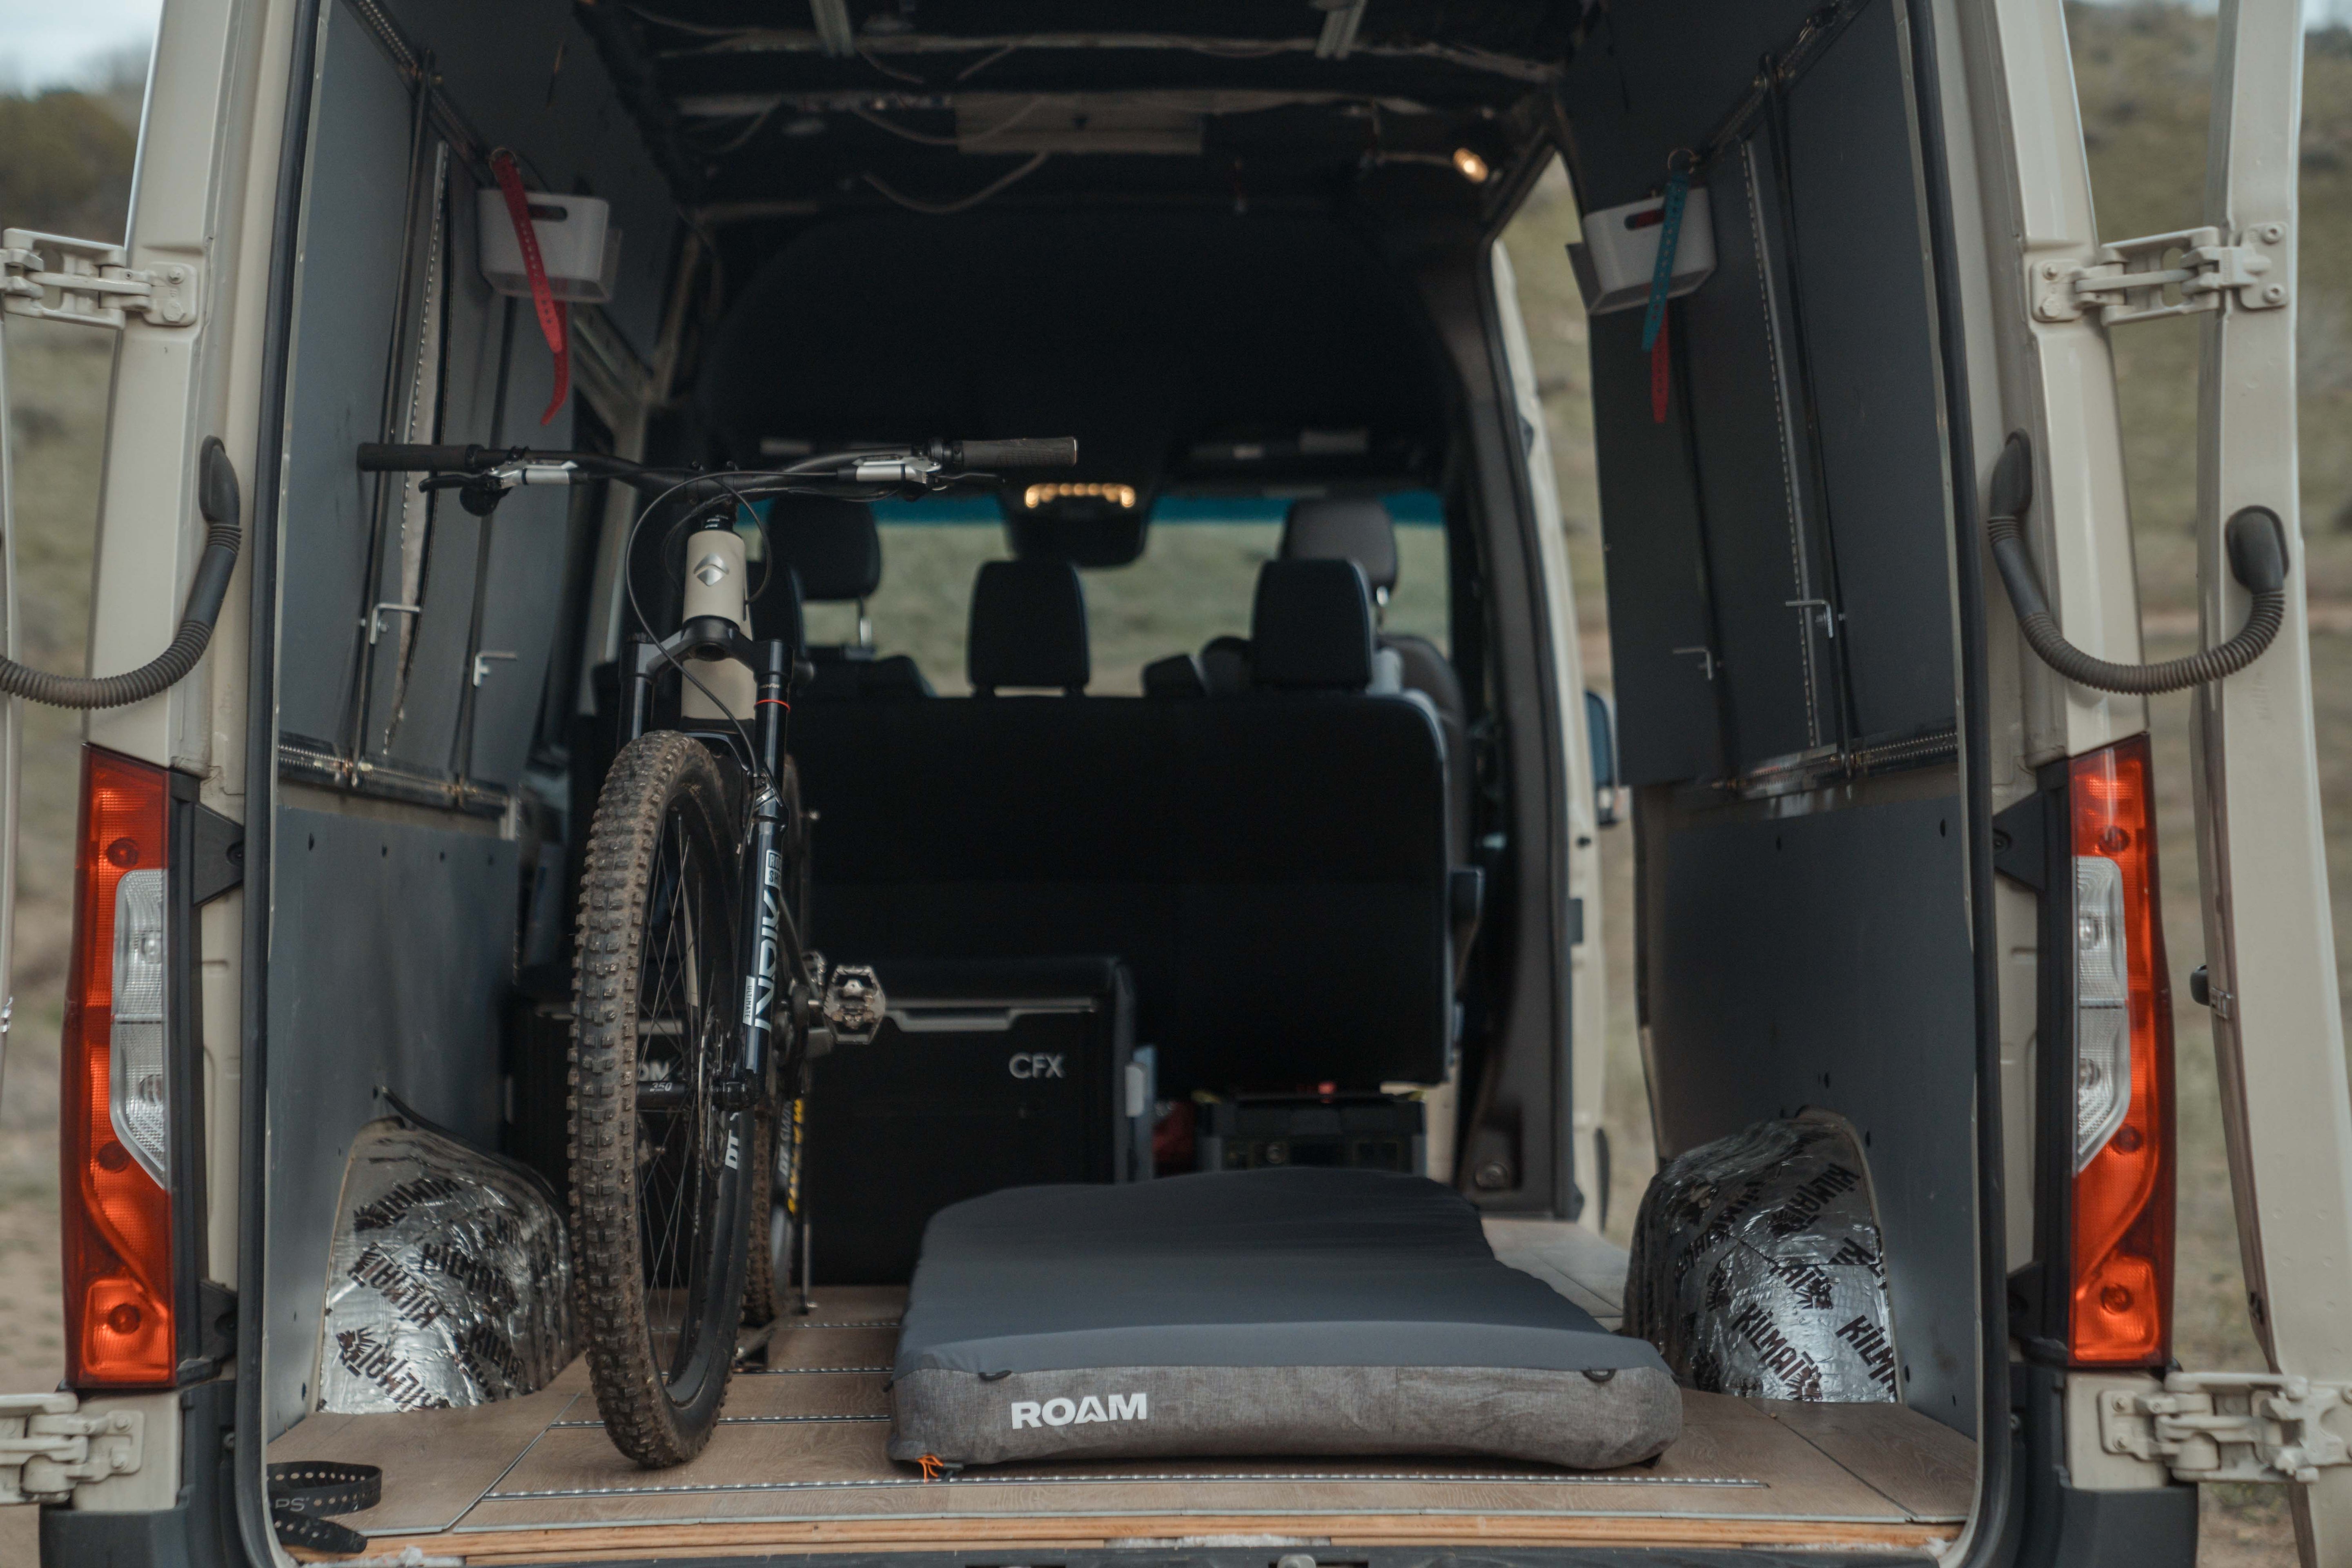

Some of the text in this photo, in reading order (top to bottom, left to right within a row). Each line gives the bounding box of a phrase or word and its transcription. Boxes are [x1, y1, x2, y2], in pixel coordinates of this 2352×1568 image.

[744, 986, 753, 1019] ULTIMATE
[1008, 1051, 1066, 1079] CFX
[1011, 1392, 1147, 1430] ROAM
